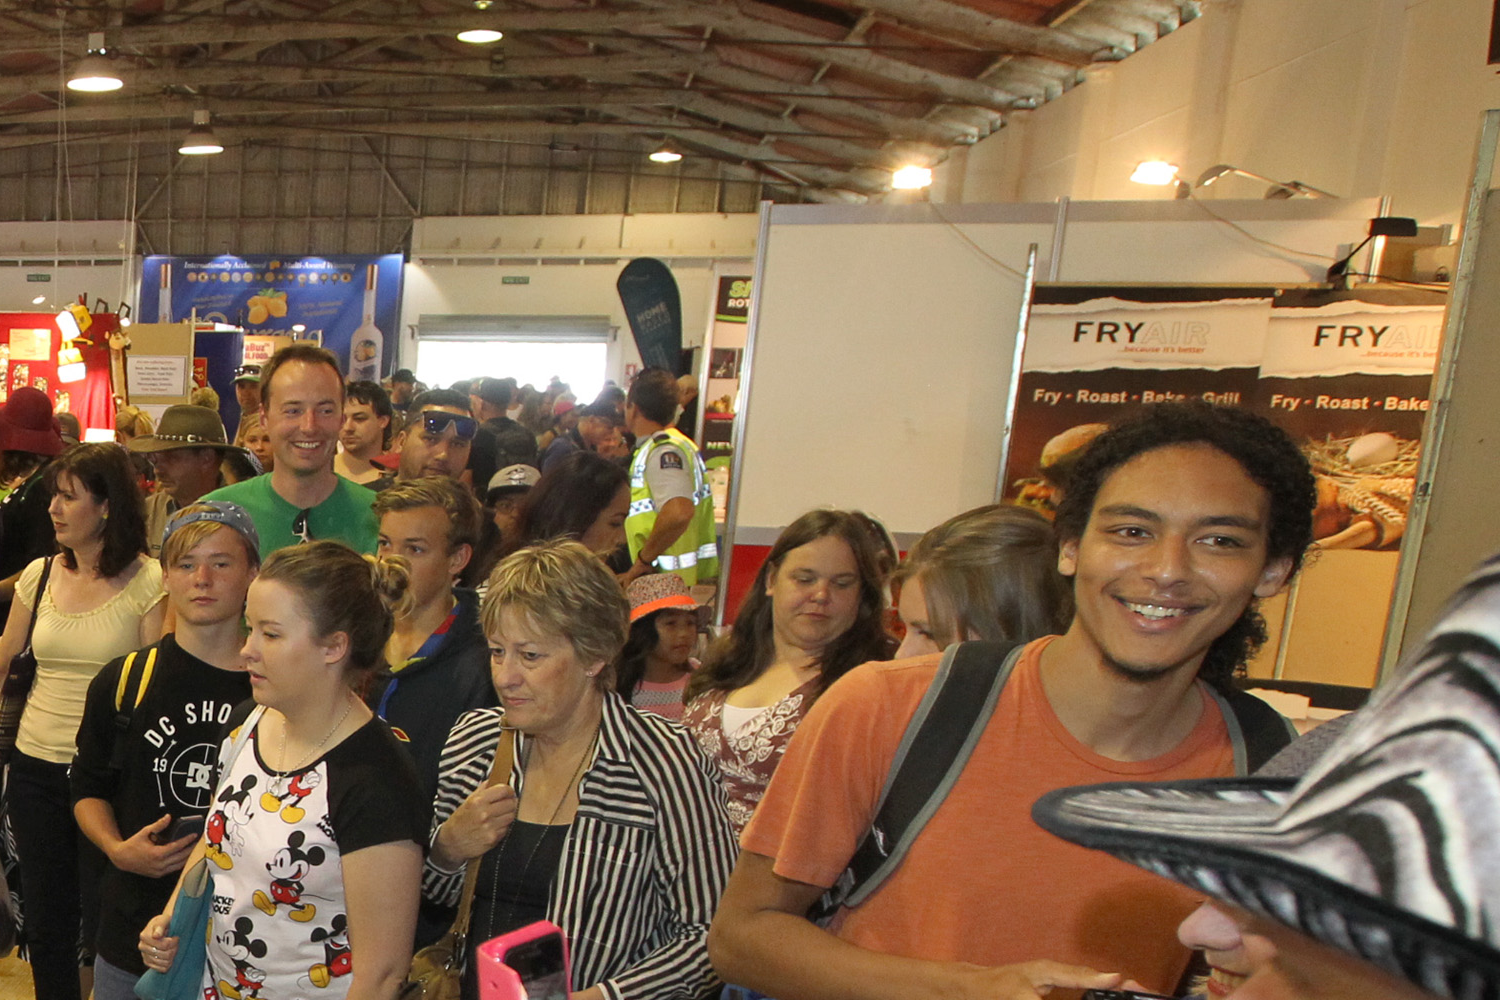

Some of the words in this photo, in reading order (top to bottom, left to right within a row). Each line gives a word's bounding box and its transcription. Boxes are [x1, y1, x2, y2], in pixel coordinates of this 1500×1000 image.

[1033, 389, 1062, 405] Fry
[1076, 389, 1129, 403] Roast
[1270, 394, 1302, 411] Fry
[1315, 395, 1370, 410] Roast
[1384, 396, 1430, 411] Bake
[143, 715, 176, 749] DC
[152, 757, 168, 772] 19
